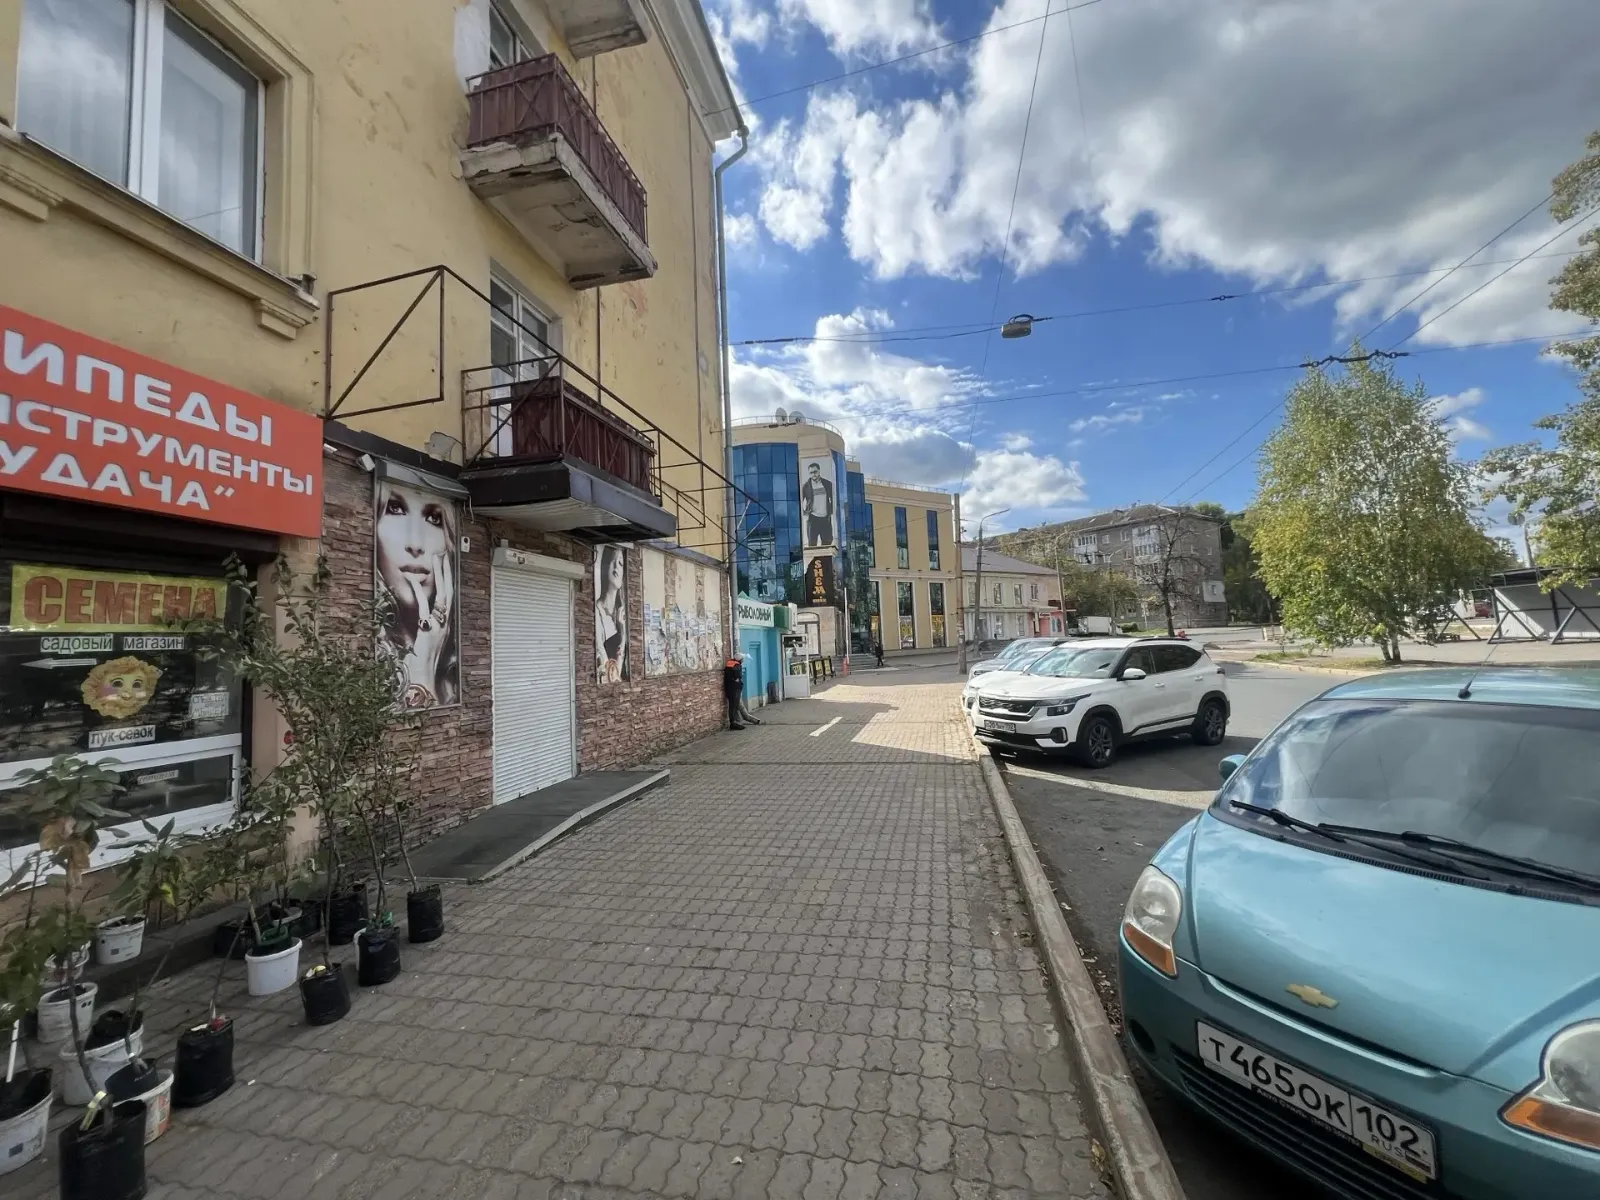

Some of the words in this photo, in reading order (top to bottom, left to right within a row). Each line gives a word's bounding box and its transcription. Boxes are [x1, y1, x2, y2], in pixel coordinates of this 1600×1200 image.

[3, 329, 272, 447] ИПЕДЫ
[23, 575, 217, 625] СЕМЕНА
[41, 633, 113, 653] садовый
[124, 636, 185, 650] магазин
[1355, 1105, 1422, 1159] 102
[1371, 1133, 1405, 1158] RUS
